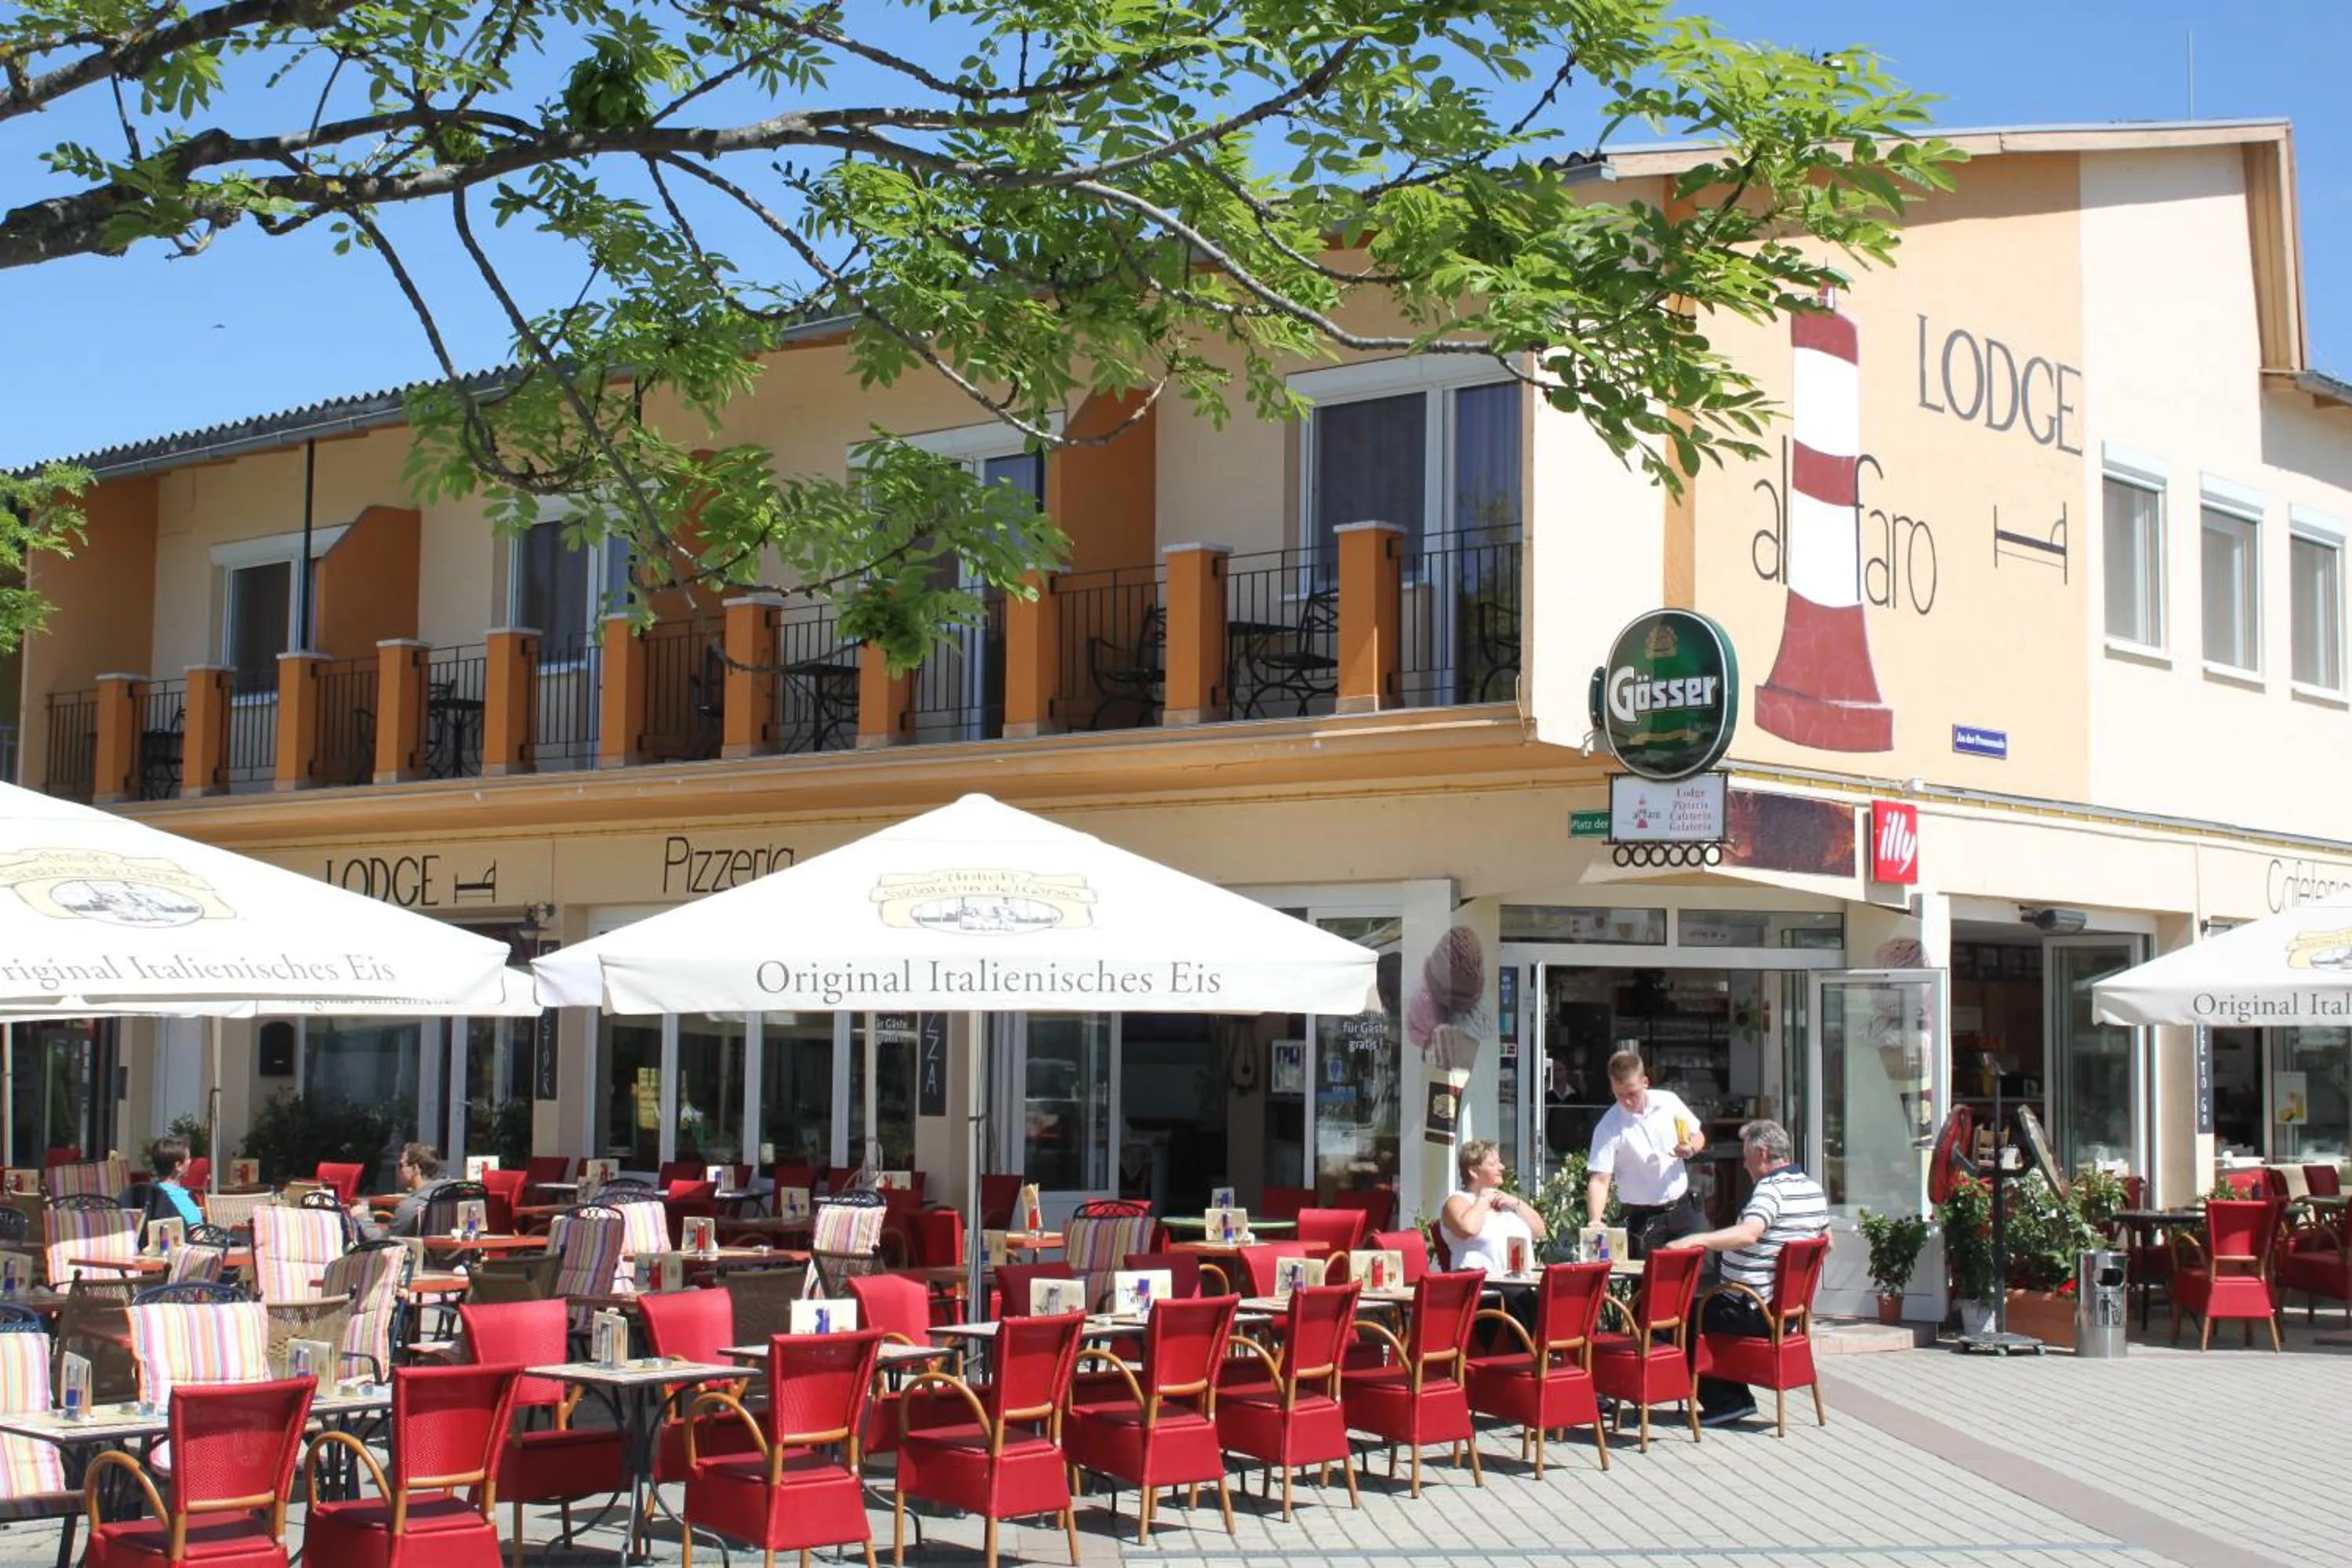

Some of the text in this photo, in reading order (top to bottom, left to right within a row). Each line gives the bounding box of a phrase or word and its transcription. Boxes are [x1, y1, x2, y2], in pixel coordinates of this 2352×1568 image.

[1918, 314, 2082, 457] LODGE
[1752, 434, 1936, 615] al faro
[1609, 666, 1718, 723] Gösser
[1676, 787, 1706, 798] Lodge
[1571, 819, 1592, 829] Platz
[1880, 811, 1916, 875] illy
[2, 953, 396, 990] riginal Italienisches Eis
[757, 958, 1221, 1004] Original Italienisches Eis
[2193, 993, 2298, 1023] Original
[1343, 1021, 1388, 1033] für Gäste
[1348, 1039, 1377, 1053] gratis
